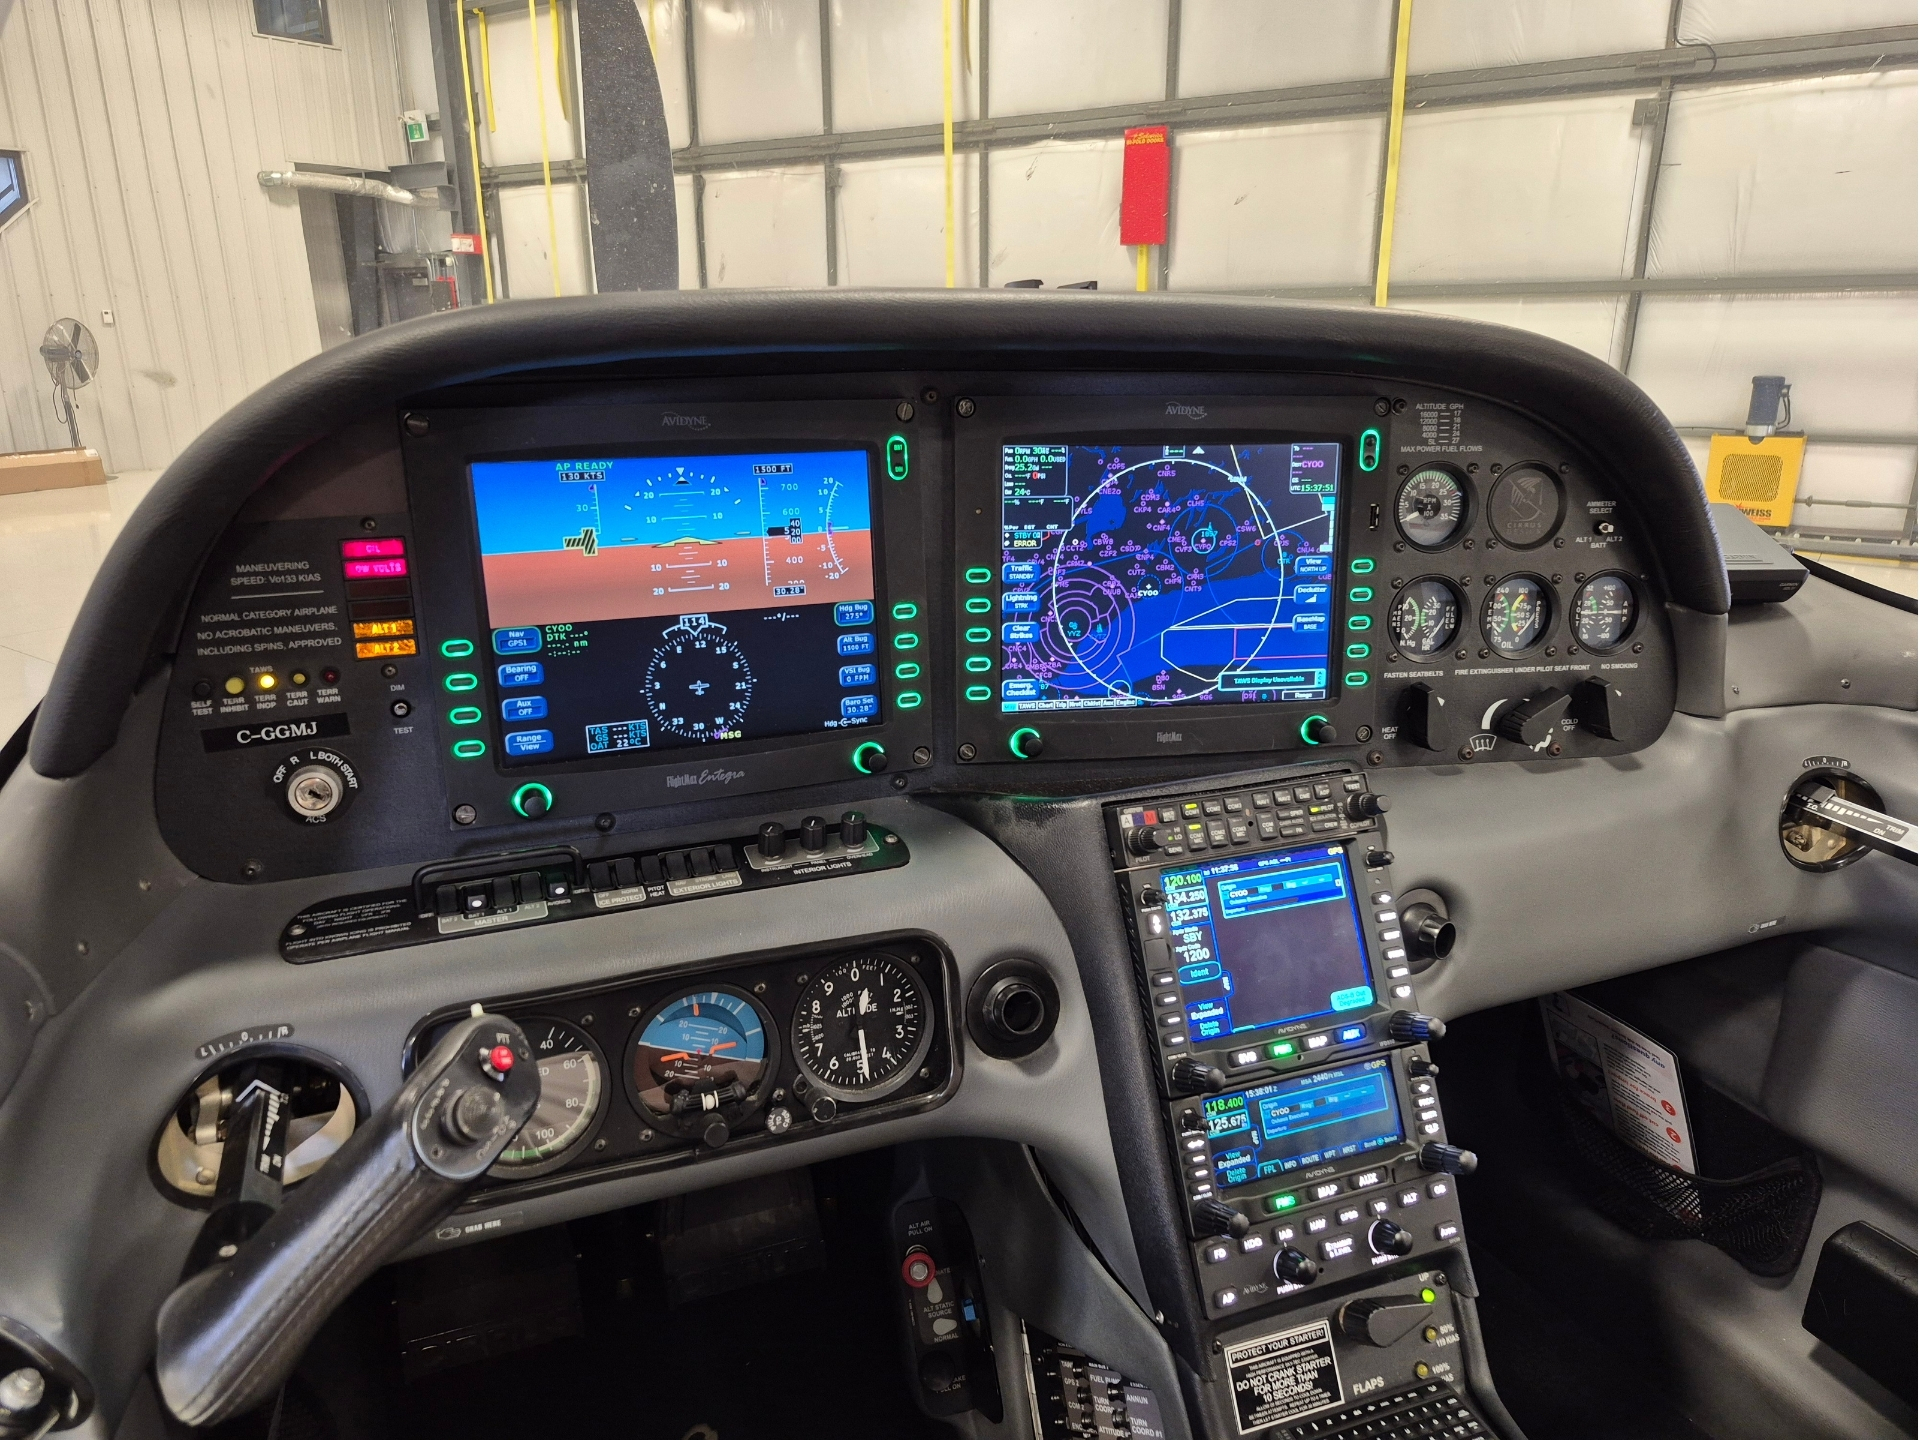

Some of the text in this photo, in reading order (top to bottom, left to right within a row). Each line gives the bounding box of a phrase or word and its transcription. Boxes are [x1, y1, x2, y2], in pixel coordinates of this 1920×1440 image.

[576, 461, 613, 470] READY
[561, 472, 603, 481] 130 KTS
[1301, 484, 1334, 492] 15:37:51
[236, 561, 309, 573] MANEUVERING
[230, 577, 267, 585] SPEED:
[299, 573, 321, 582] KIAS
[201, 606, 338, 623] NORMAL CATEGORY AIRPLANE
[683, 617, 705, 626] 114
[546, 624, 572, 632] CYOO
[197, 632, 213, 640] NO
[215, 627, 271, 639] ACROBATIC
[197, 637, 342, 656] INCLUDING SPINS, APPROVED
[508, 639, 527, 647] GPS1
[506, 665, 536, 674] Bearing
[1409, 670, 1443, 678] SEATBELTS
[1470, 666, 1514, 674] EXTINGUISHER
[317, 688, 338, 696] TERR
[390, 684, 405, 692] DIM
[254, 694, 277, 702] TERR
[286, 691, 308, 699] TERR
[316, 694, 341, 703] WARN
[190, 700, 212, 708] SELF
[222, 697, 245, 705] TERR
[256, 702, 277, 710] INOP
[287, 698, 308, 706] CAUT
[192, 707, 213, 716] TEST
[220, 703, 249, 713] INHIBIT
[628, 722, 646, 730] KTS
[236, 722, 318, 743] C-GGMJ
[1157, 732, 1182, 742] FlightMax
[1383, 732, 1397, 740] OFF
[516, 734, 541, 743] Range
[318, 751, 343, 767] BOTH
[273, 765, 287, 784] OFF
[340, 763, 358, 789] START
[699, 769, 745, 784] Entegra
[1807, 803, 1818, 811] T.O.
[306, 814, 326, 823] ACS
[1873, 828, 1885, 836] DN
[1886, 824, 1905, 835] TRIM
[793, 861, 852, 875] INTERIOR LIGHTS
[1164, 874, 1201, 887] 120.100
[673, 878, 738, 894] EXTERIOR LIGHTS
[611, 894, 643, 903] PROTECT
[1167, 890, 1205, 904] 134.250
[1170, 907, 1208, 921] 132.375
[474, 916, 508, 926] MASTER
[1183, 932, 1202, 942] SBY
[1184, 948, 1210, 962] 1200
[851, 968, 859, 981] 0
[893, 990, 901, 1001] 2
[812, 1000, 820, 1013] 8
[1191, 1007, 1223, 1020] Expanded
[896, 1025, 904, 1038] 3
[540, 1040, 554, 1049] 40
[563, 1059, 576, 1069] 60
[1245, 1086, 1274, 1098] 15:38:01
[566, 1098, 578, 1108] 80
[1204, 1096, 1244, 1112] 118.400
[536, 1128, 554, 1140] 100
[1218, 1155, 1250, 1168] Expanded
[1302, 1154, 1320, 1164] ROUTE
[1264, 1164, 1276, 1174] FPL
[1358, 1172, 1378, 1186] AUX
[465, 1220, 501, 1233] GRAB HERE
[908, 1228, 922, 1236] PULL
[1419, 1274, 1430, 1282] UP
[936, 1301, 954, 1310] STATIC
[928, 1308, 952, 1317] SOURCE
[934, 1333, 958, 1342] NORMAL
[1232, 1329, 1324, 1361] PROTECT YOUR STARTER!
[1236, 1382, 1250, 1392] DO
[1250, 1376, 1268, 1390] NOT
[1268, 1366, 1296, 1384] CRANK
[1296, 1356, 1332, 1376] STARTER
[1432, 1364, 1450, 1374] 100%
[1090, 1375, 1104, 1384] FUEL
[1254, 1370, 1318, 1396] FOR MORE THAN
[1353, 1376, 1384, 1395] FLAPS
[1264, 1381, 1313, 1402] 10 SECONDS!
[1127, 1394, 1148, 1404] ANNUN
[1131, 1417, 1147, 1427] TURN
[1132, 1426, 1154, 1437] COORD
